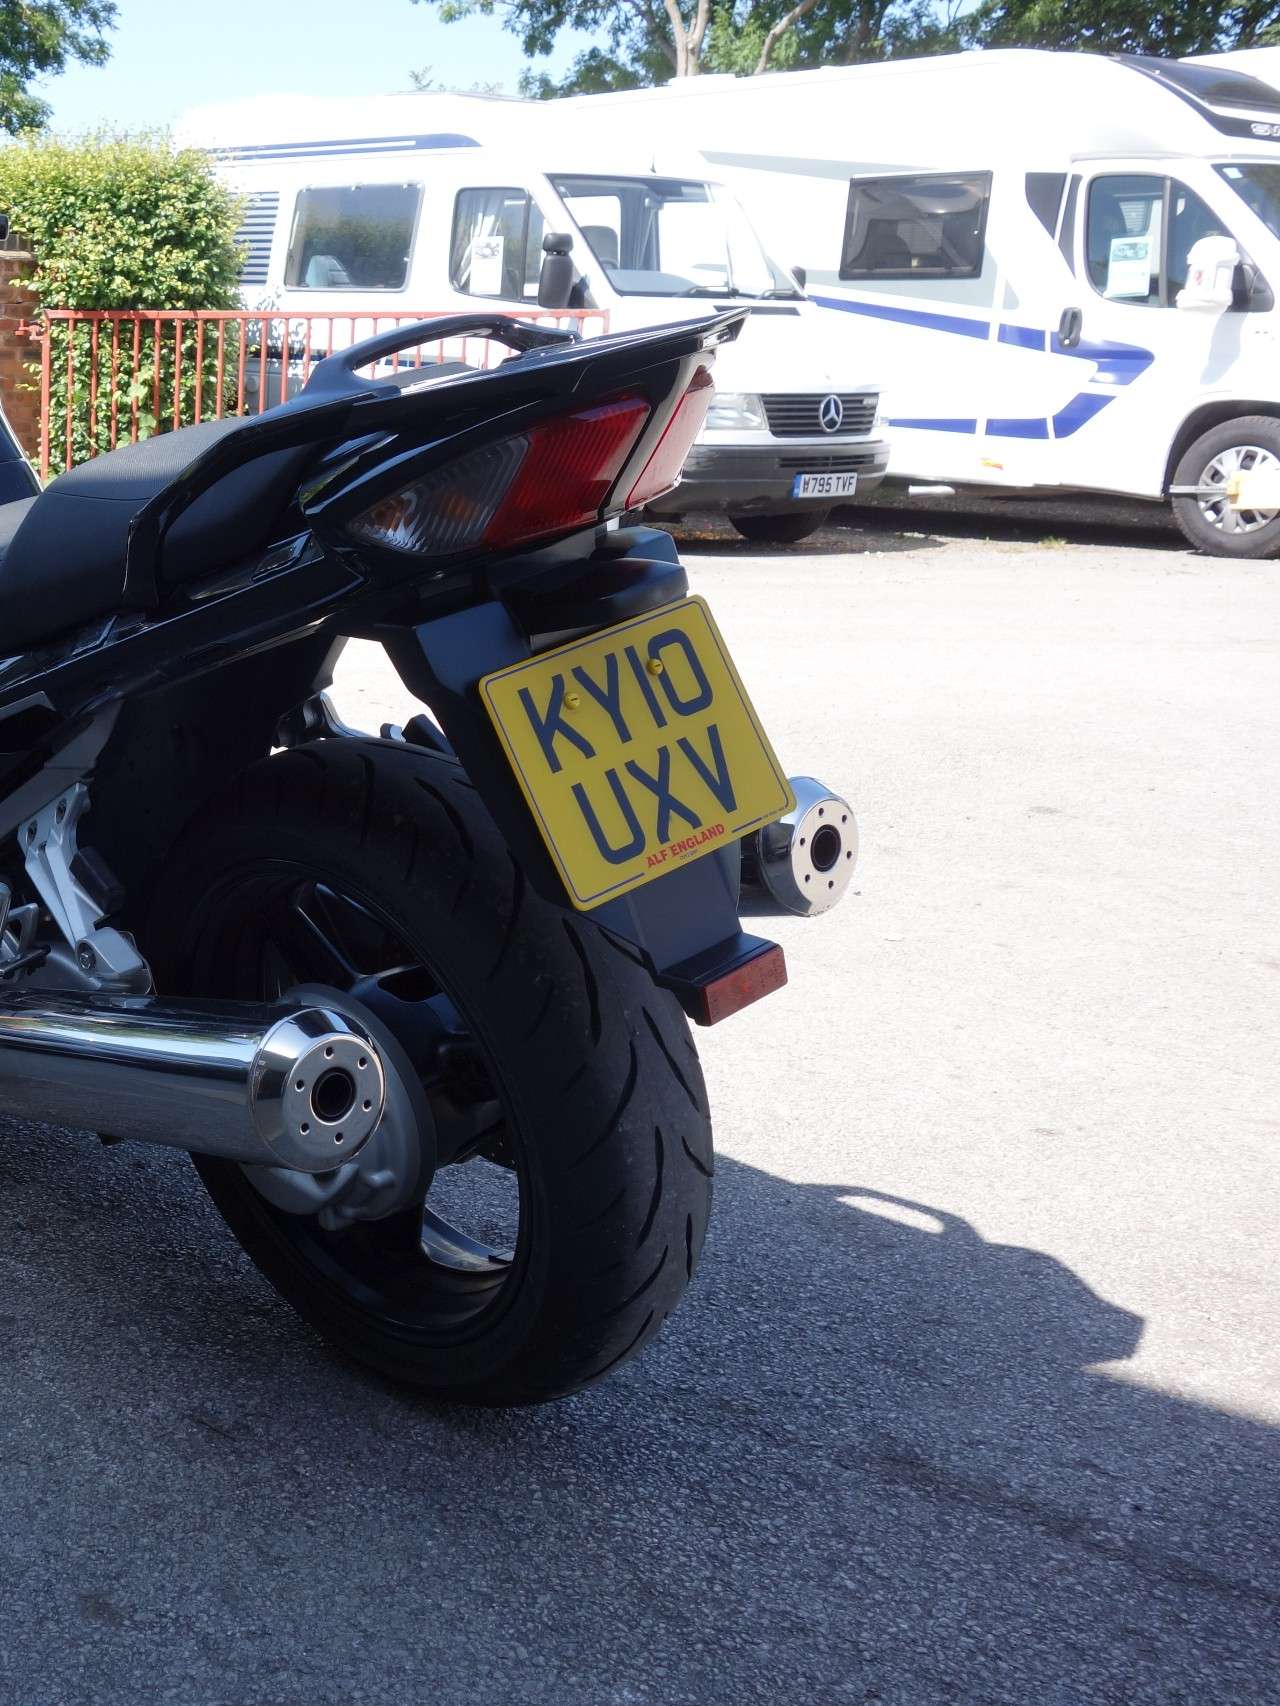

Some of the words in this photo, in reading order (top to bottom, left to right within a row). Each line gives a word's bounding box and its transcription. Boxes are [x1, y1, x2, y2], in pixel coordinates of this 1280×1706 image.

[836, 475, 855, 492] TVF
[517, 628, 713, 774] KY10
[570, 723, 738, 865] UXV
[646, 851, 670, 868] ALF
[671, 823, 726, 857] ENGLAND
